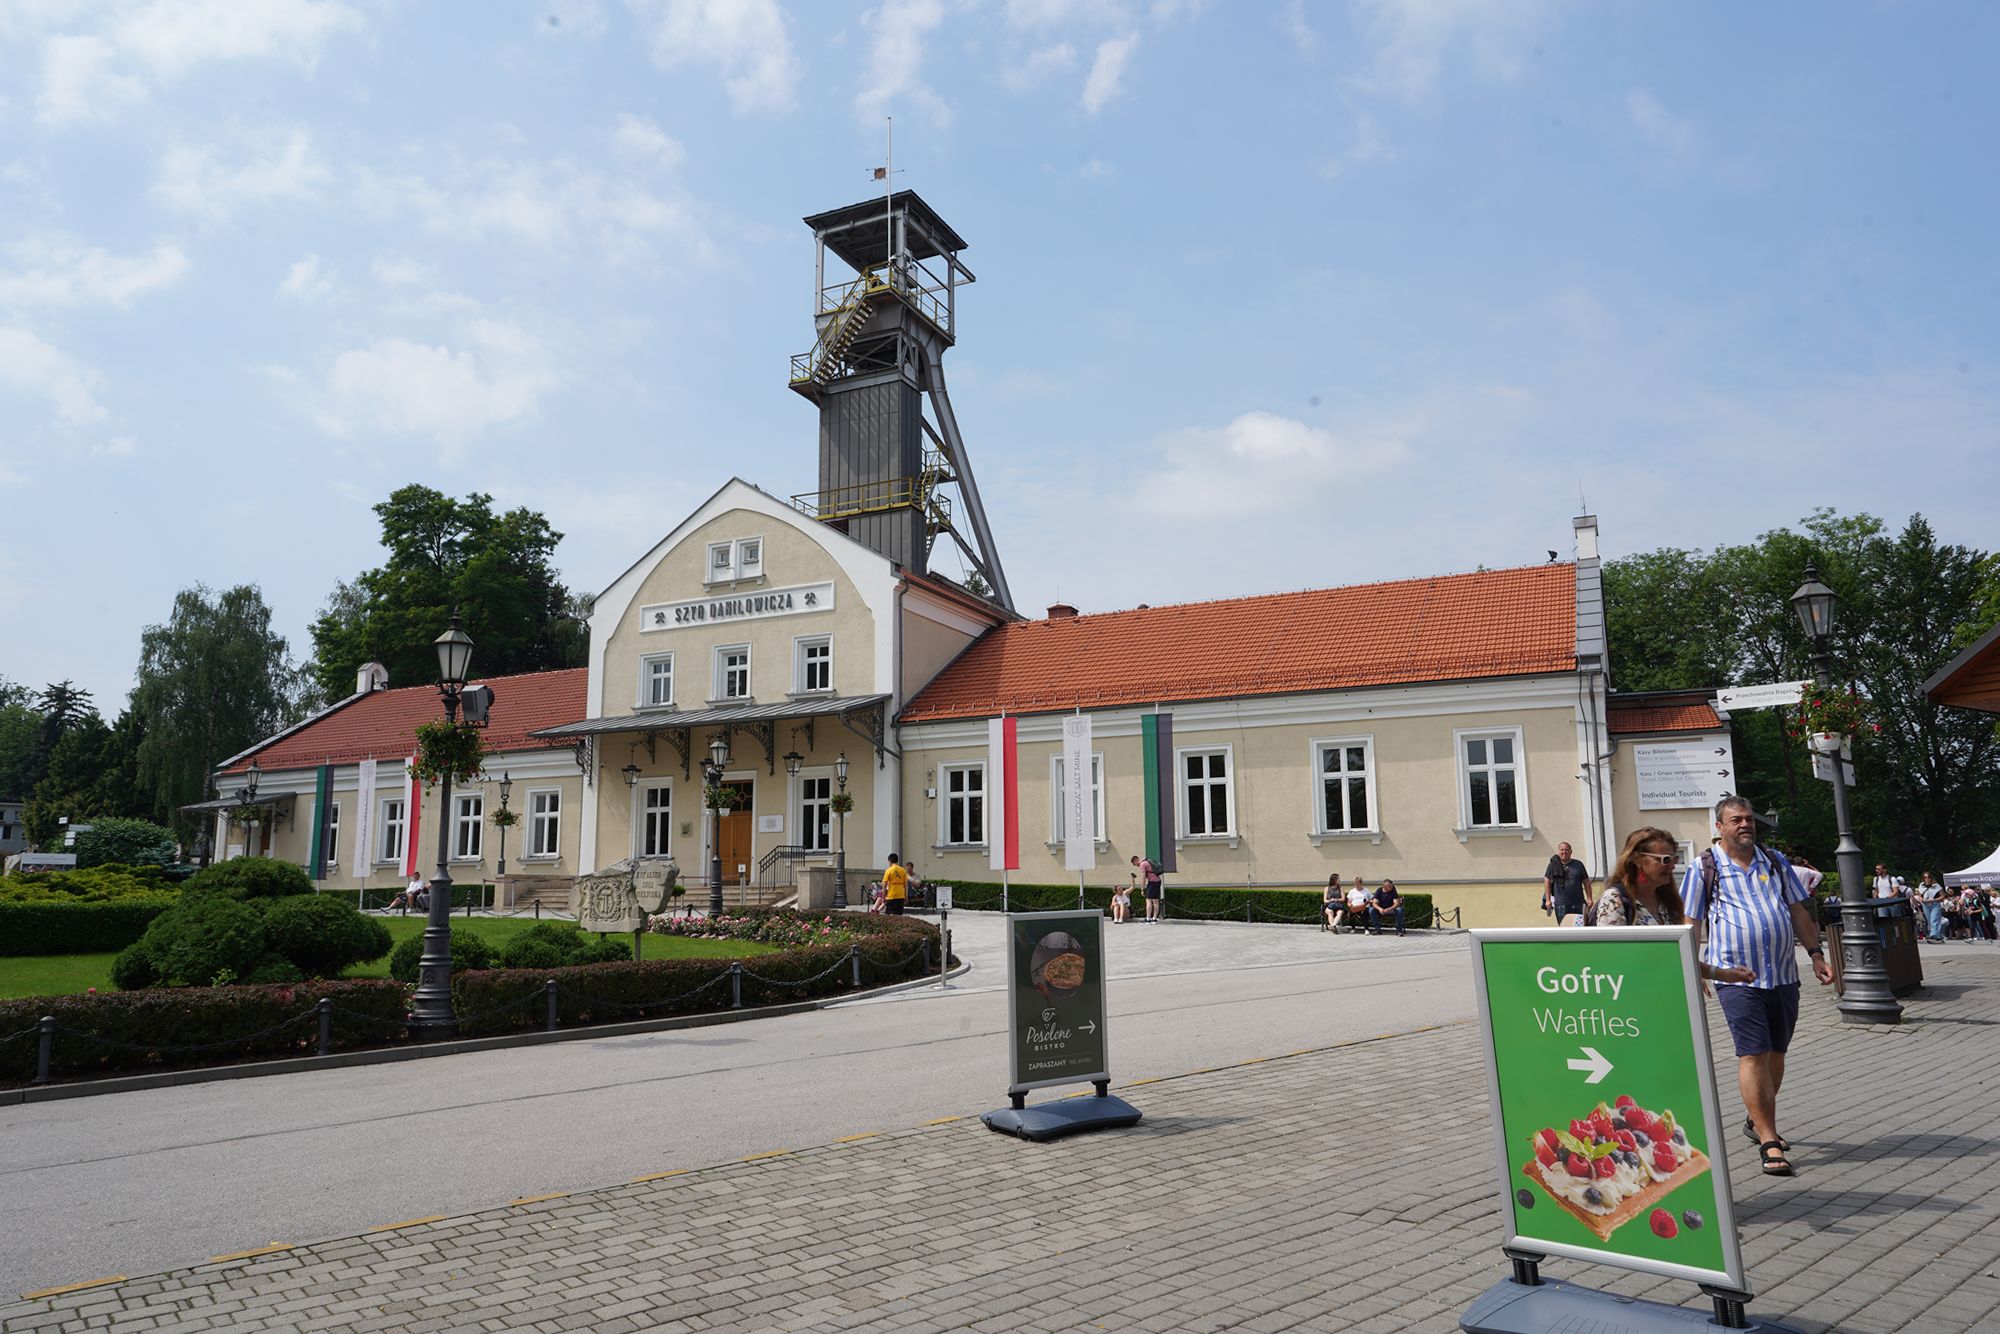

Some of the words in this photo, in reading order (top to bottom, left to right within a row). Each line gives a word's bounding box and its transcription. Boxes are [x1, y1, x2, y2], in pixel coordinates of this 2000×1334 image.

[675, 604, 704, 623] SZYB
[709, 593, 793, 618] DANIŁOWICZA
[1642, 791, 1676, 799] Individual
[1678, 790, 1707, 798] Tourists
[1536, 966, 1625, 1001] Gofry
[1532, 1007, 1640, 1037] Waffles
[1034, 1042, 1065, 1051] BISTRO
[1028, 1059, 1067, 1070] ZAPRASZAMY
